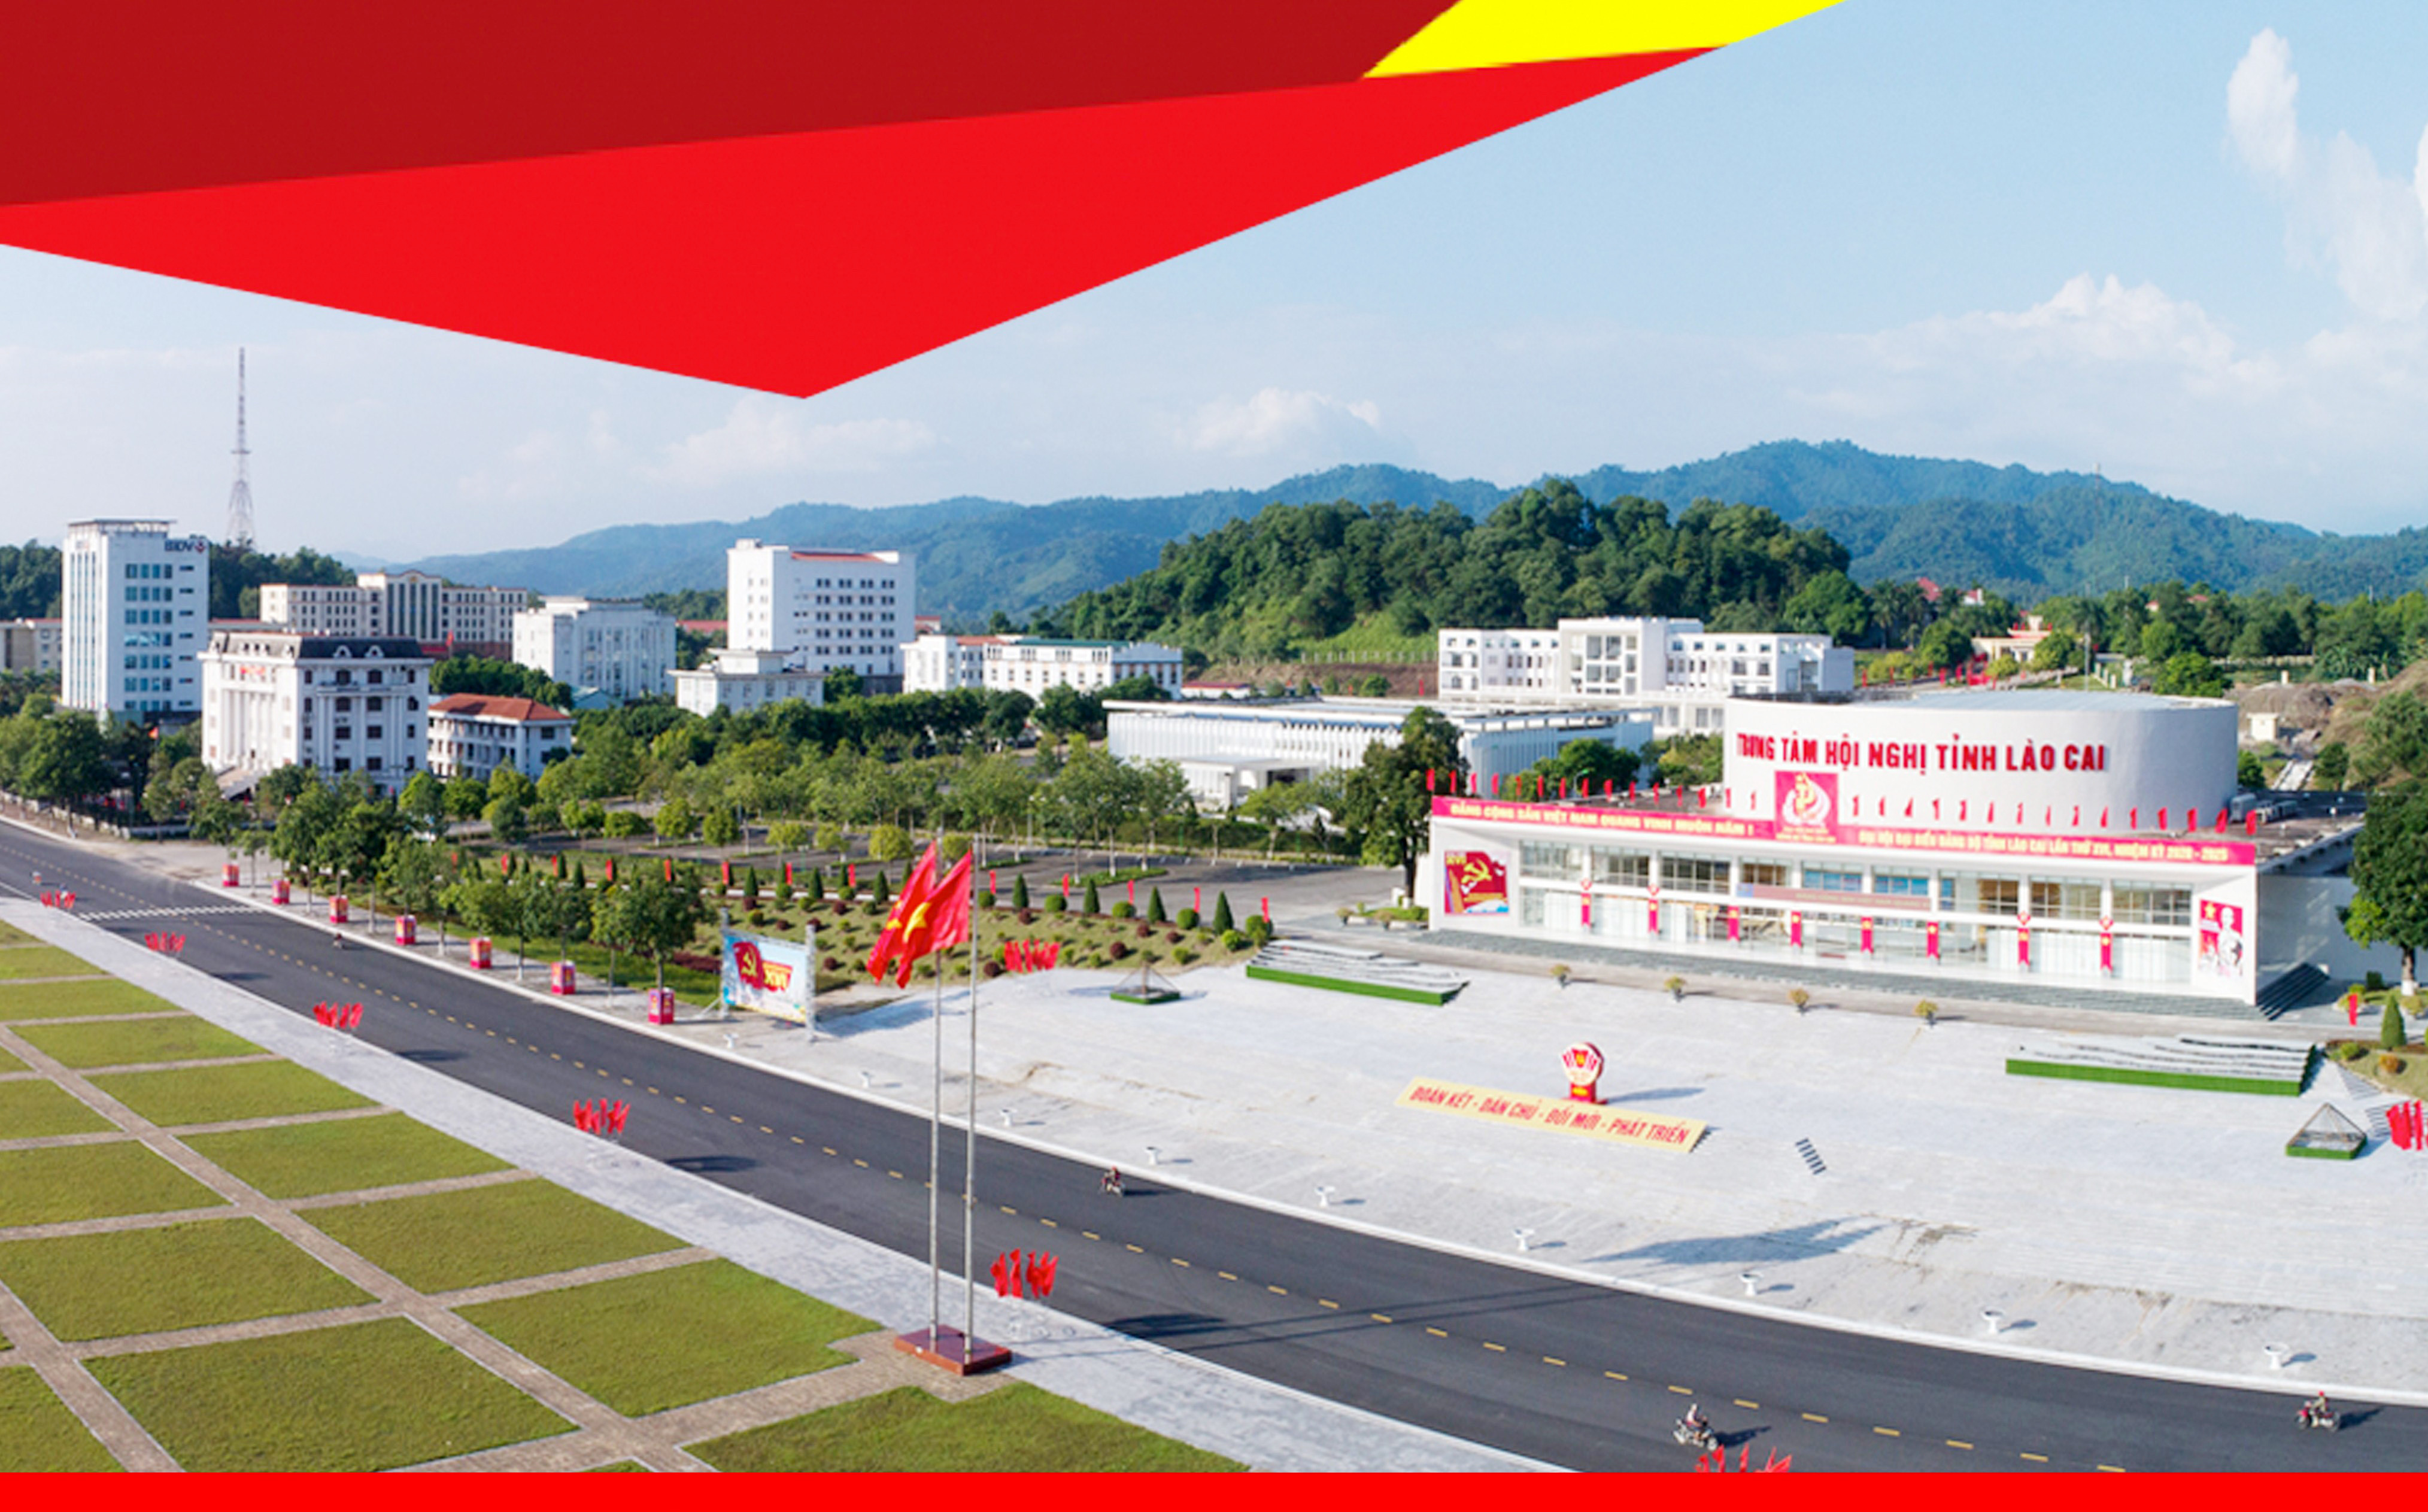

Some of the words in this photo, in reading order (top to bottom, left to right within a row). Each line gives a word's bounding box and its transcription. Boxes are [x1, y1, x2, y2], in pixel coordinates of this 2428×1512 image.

[1737, 733, 1774, 760] TRUNG
[1781, 730, 1817, 764] TÂM
[1825, 733, 1859, 771] HỘI
[1868, 742, 1926, 775] NGHỊ
[1935, 733, 1996, 770] TỈNH
[2005, 739, 2056, 771] LÀO
[2064, 744, 2105, 771] CAI
